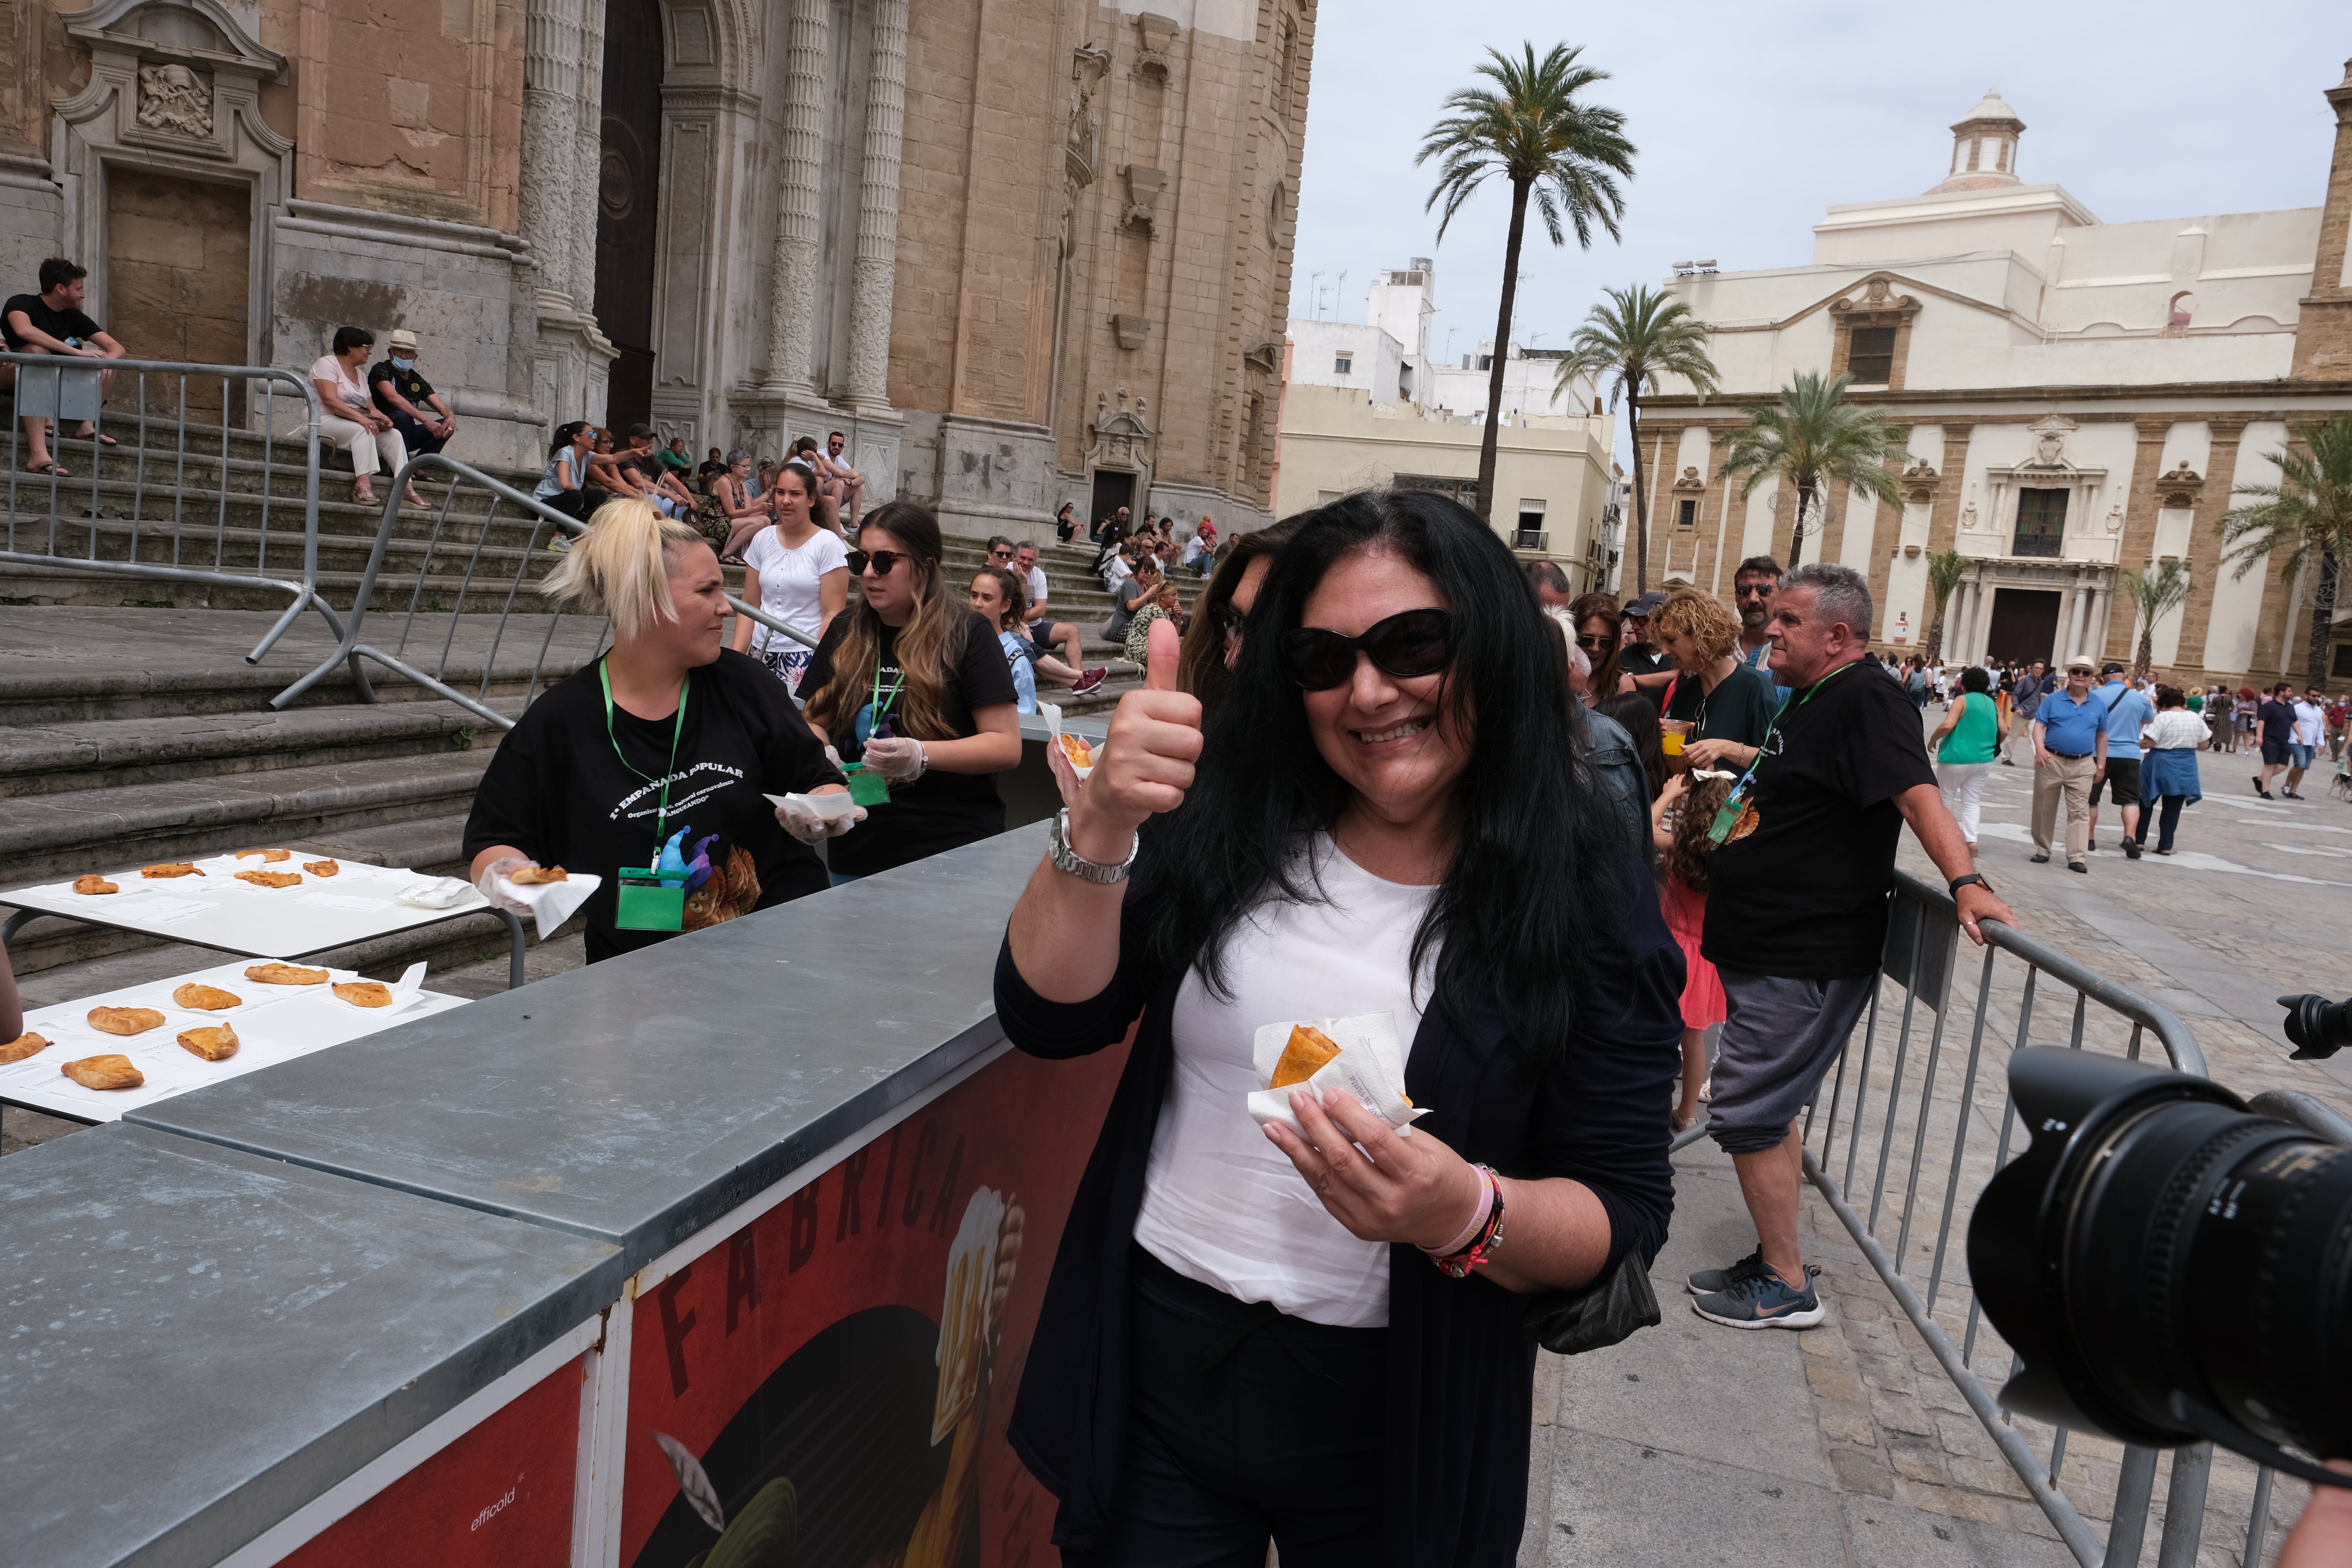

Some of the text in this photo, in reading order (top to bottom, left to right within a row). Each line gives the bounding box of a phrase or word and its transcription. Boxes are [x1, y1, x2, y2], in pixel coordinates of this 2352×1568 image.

[619, 772, 688, 810] EMPANADA
[628, 808, 657, 819] Organiza:
[674, 792, 695, 807] cultural
[696, 780, 734, 796] carnavalesca
[1349, 1076, 1365, 1097] visita
[1364, 1097, 1372, 1106] su
[471, 1487, 515, 1531] efficold
